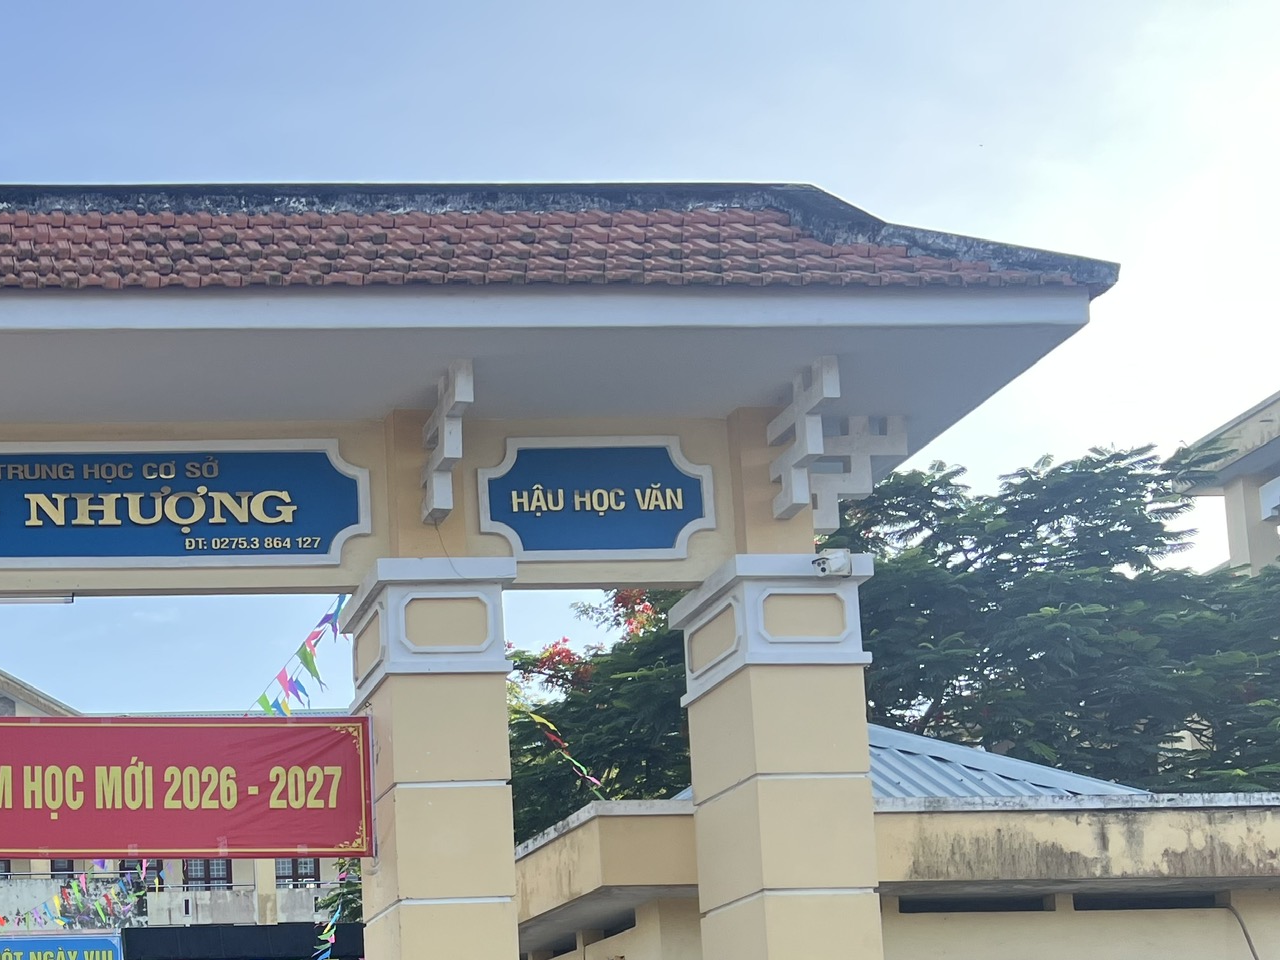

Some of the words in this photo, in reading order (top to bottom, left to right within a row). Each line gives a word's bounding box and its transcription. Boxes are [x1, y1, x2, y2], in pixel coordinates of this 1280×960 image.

[83, 463, 133, 483] HỌC
[142, 460, 176, 479] CƠ
[185, 456, 219, 479] SỞ
[24, 486, 297, 534] NHƯỢNG
[511, 484, 564, 516] HẬU
[574, 488, 625, 516] HỌC
[635, 483, 683, 510] VĂN
[185, 538, 207, 550] ĐT:
[211, 538, 259, 549] 0275.3
[264, 538, 291, 549] 864
[296, 537, 321, 548] 127
[23, 765, 84, 820] HỌC
[94, 756, 153, 810] MỚI
[163, 765, 238, 810] 2026
[247, 786, 259, 795] -
[269, 765, 343, 809] 2027
